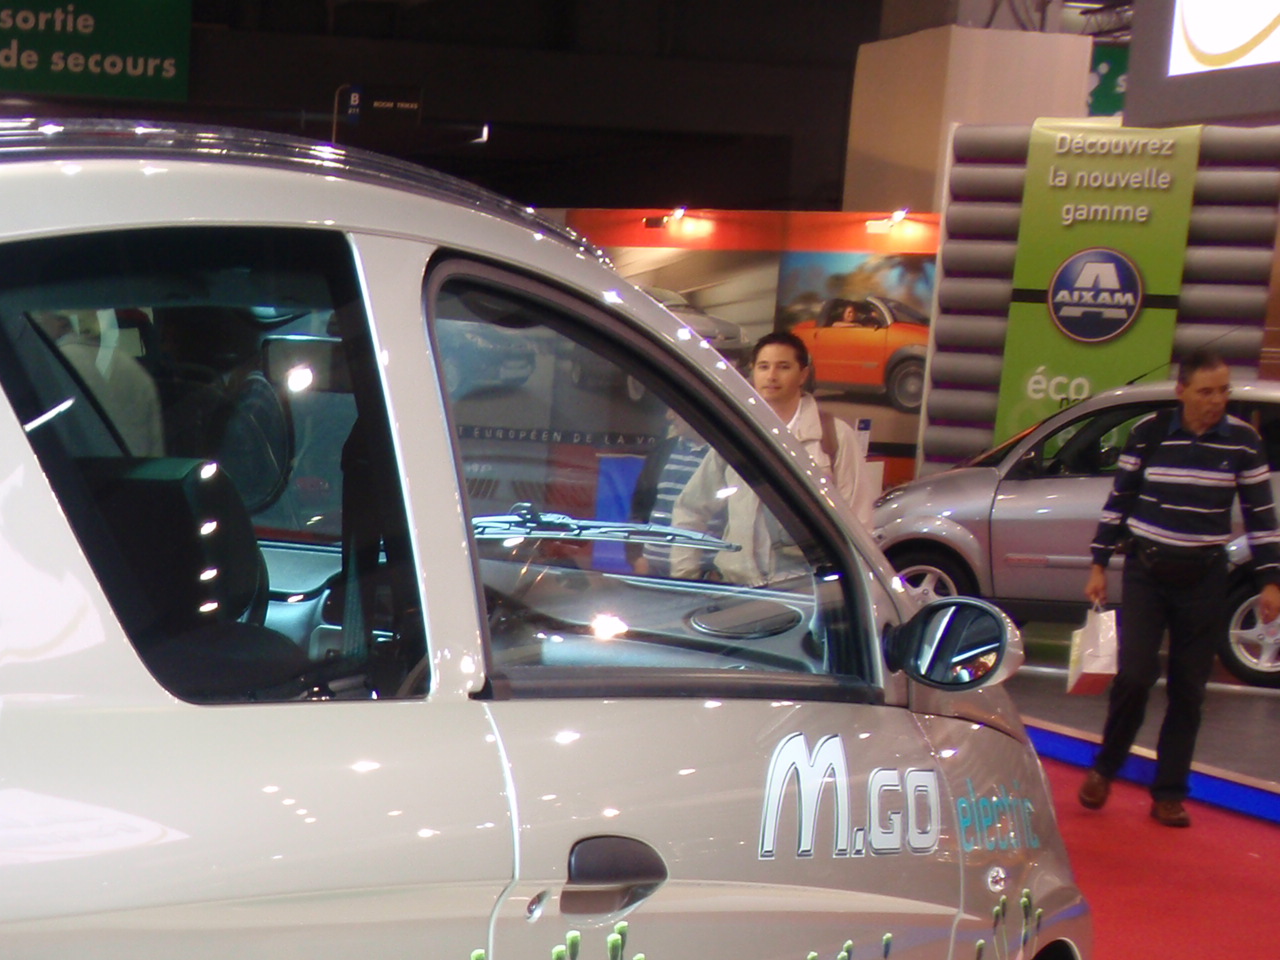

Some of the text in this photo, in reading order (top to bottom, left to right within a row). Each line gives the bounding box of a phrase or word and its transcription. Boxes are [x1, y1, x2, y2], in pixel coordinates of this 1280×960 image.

[0, 5, 95, 33] sortie
[50, 50, 177, 78] secours
[1055, 133, 1176, 157] Découvrez
[1048, 166, 1172, 190] la nouvelle
[1061, 202, 1150, 227] gamme
[1053, 289, 1136, 306] AIXAM
[1027, 366, 1091, 400] éco
[758, 731, 942, 861] M.GO
